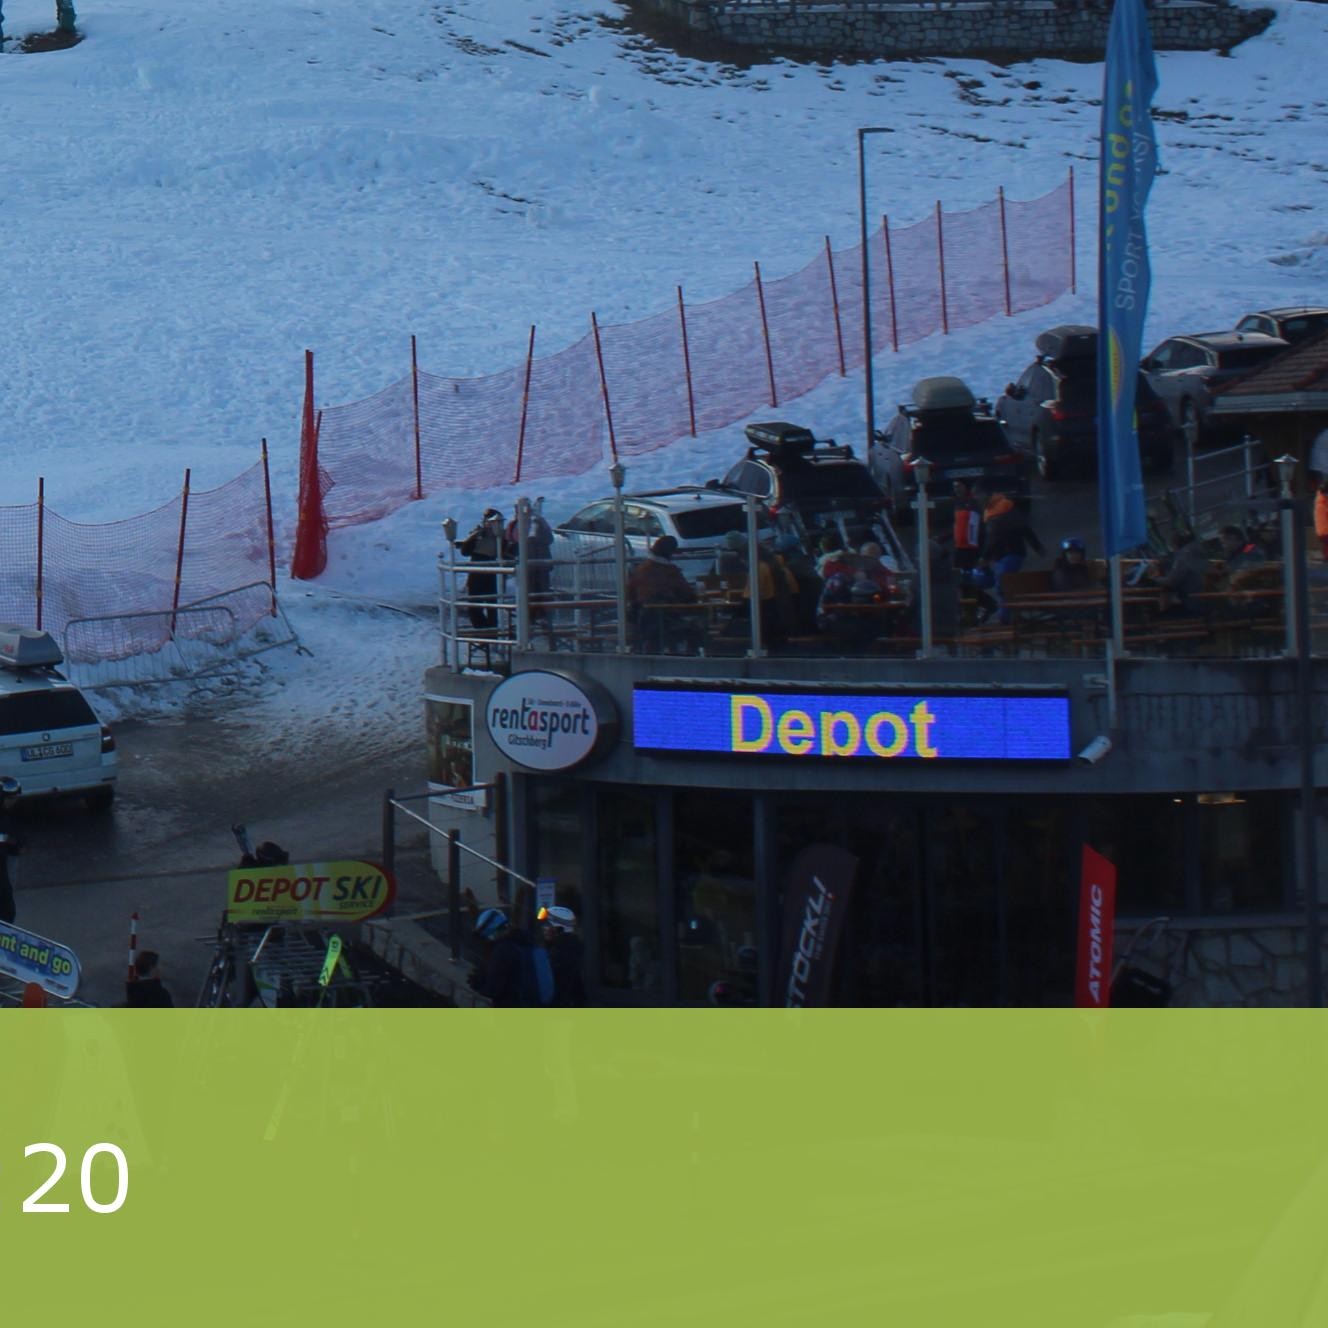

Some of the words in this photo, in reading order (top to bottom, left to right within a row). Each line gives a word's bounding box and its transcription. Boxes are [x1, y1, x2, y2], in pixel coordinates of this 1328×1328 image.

[491, 697, 590, 748] rentasport
[730, 695, 938, 758] Depot
[233, 877, 330, 903] DEPOT
[332, 875, 383, 901] SKI
[19, 943, 50, 965] and
[52, 956, 72, 975] go
[1088, 883, 1102, 1004] ATOMIC
